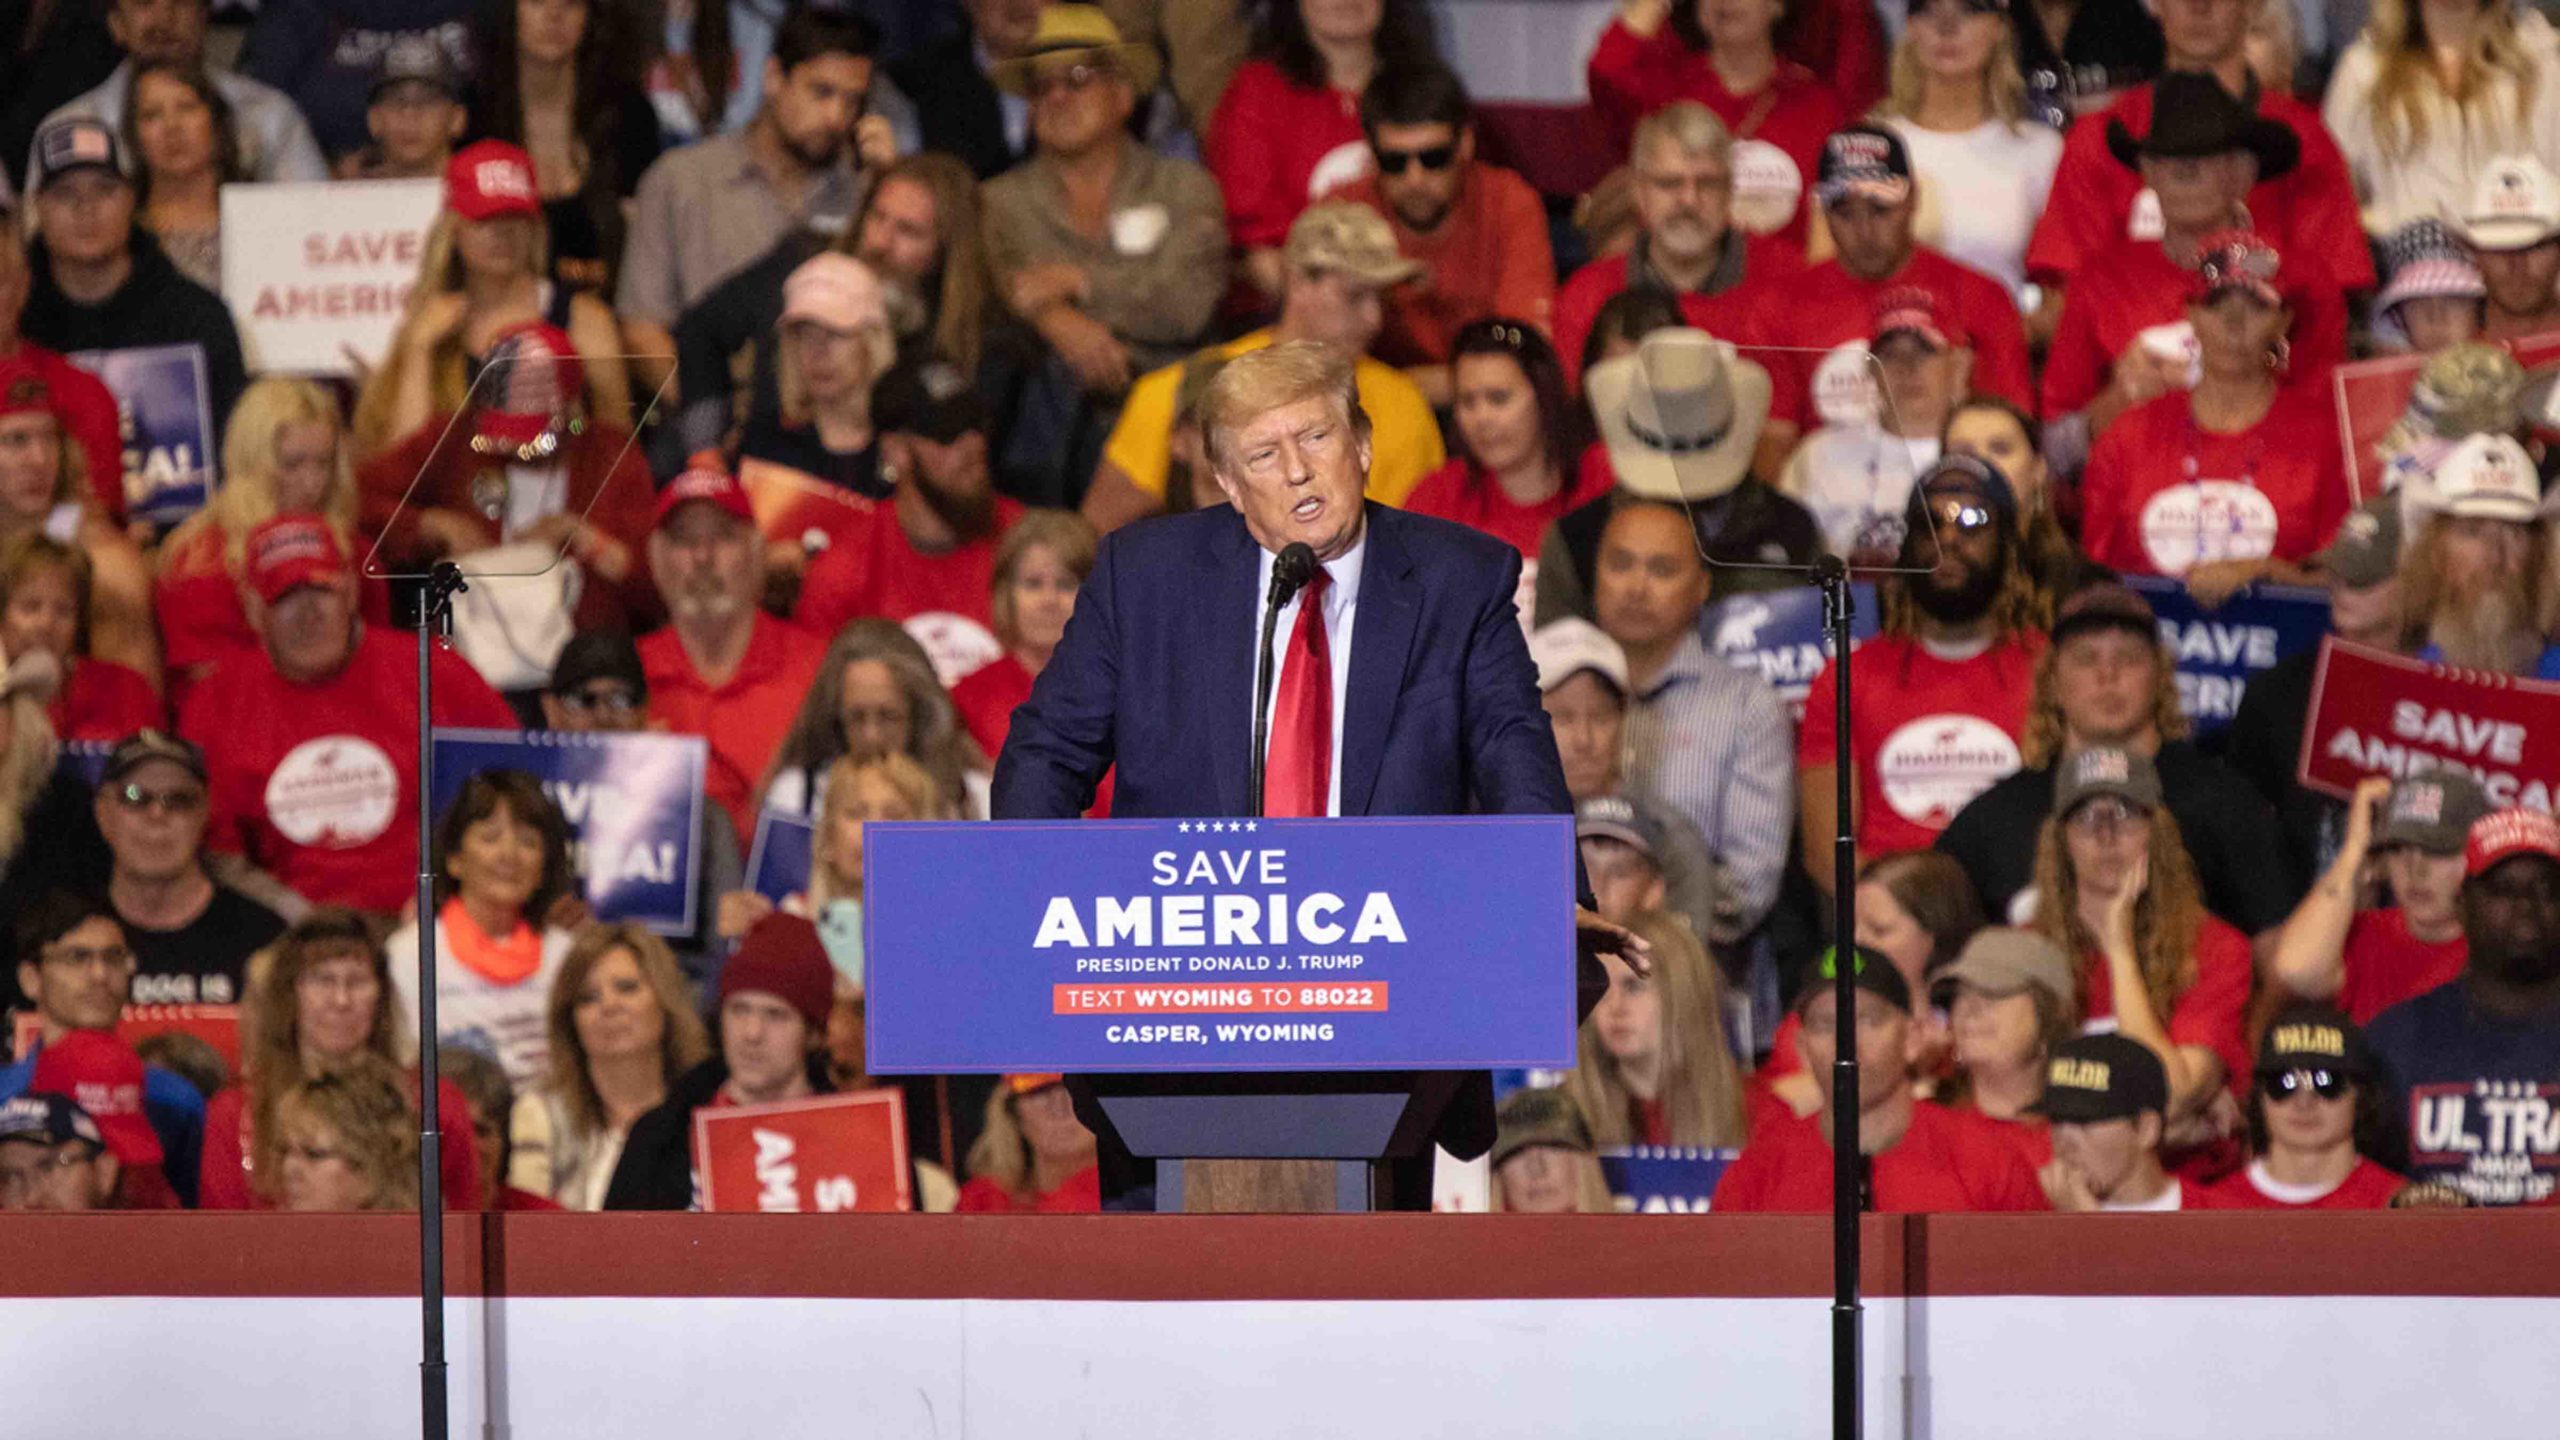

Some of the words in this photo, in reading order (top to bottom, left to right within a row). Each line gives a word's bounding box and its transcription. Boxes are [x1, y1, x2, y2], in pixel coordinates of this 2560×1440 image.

[305, 231, 417, 266] SAVE
[2392, 698, 2528, 765] SAVE
[1152, 850, 1287, 886] SAVE
[1032, 892, 1408, 948] AMERICA
[1076, 957, 1182, 973] PRESIDENT
[1189, 955, 1271, 972] DONALD
[1277, 956, 1292, 971] J.
[1299, 955, 1364, 970] TRUMP
[1067, 990, 1126, 1008] TEXT
[1134, 989, 1253, 1007] WYOMING
[1261, 989, 1292, 1006] TO
[1300, 987, 1374, 1006] 88022
[1106, 1025, 1208, 1045] CASPER,
[1216, 1023, 1335, 1042] WYOMING
[2272, 1022, 2345, 1057] VALOR
